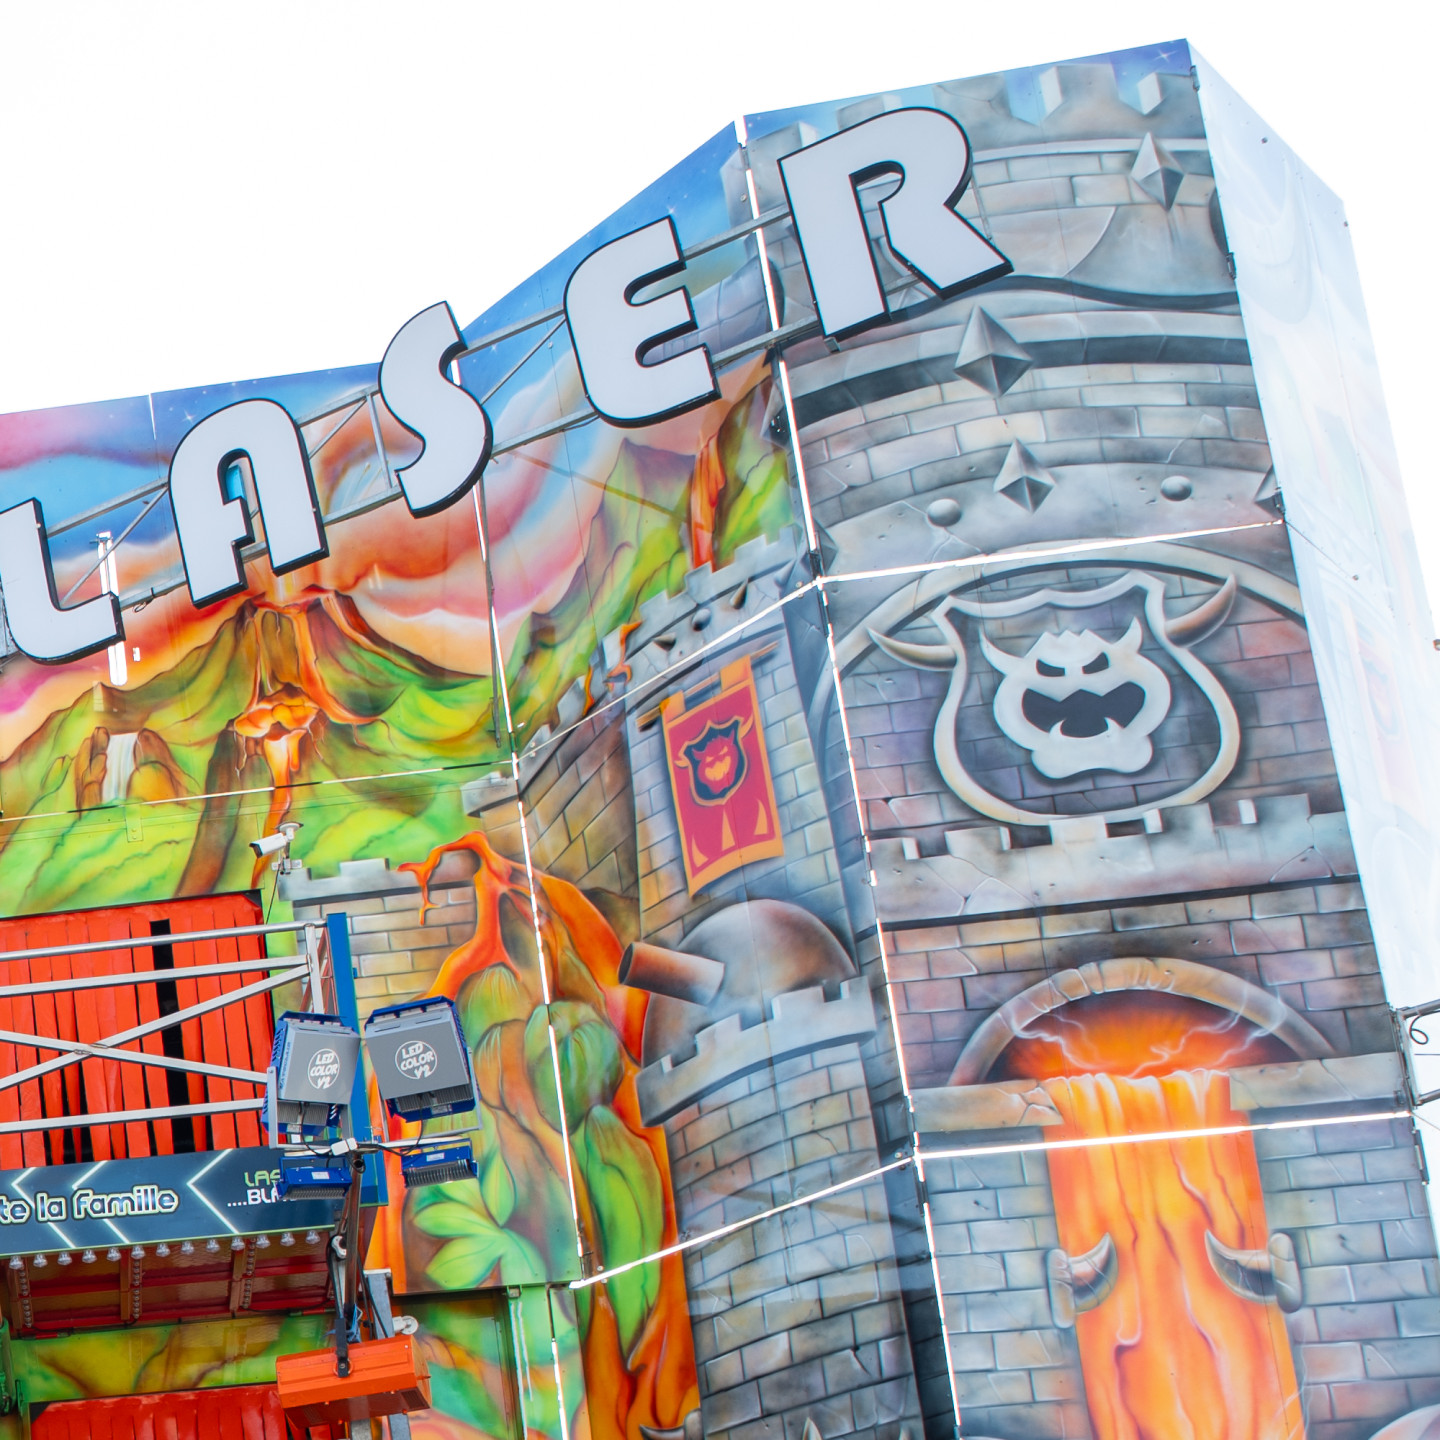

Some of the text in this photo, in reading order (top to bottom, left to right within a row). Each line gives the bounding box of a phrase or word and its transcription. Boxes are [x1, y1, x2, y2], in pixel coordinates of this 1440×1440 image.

[315, 1052, 334, 1065] LED
[401, 1043, 423, 1059] LED
[310, 1062, 338, 1076] COLOR
[400, 1051, 434, 1071] COLOR
[36, 1192, 67, 1222] la
